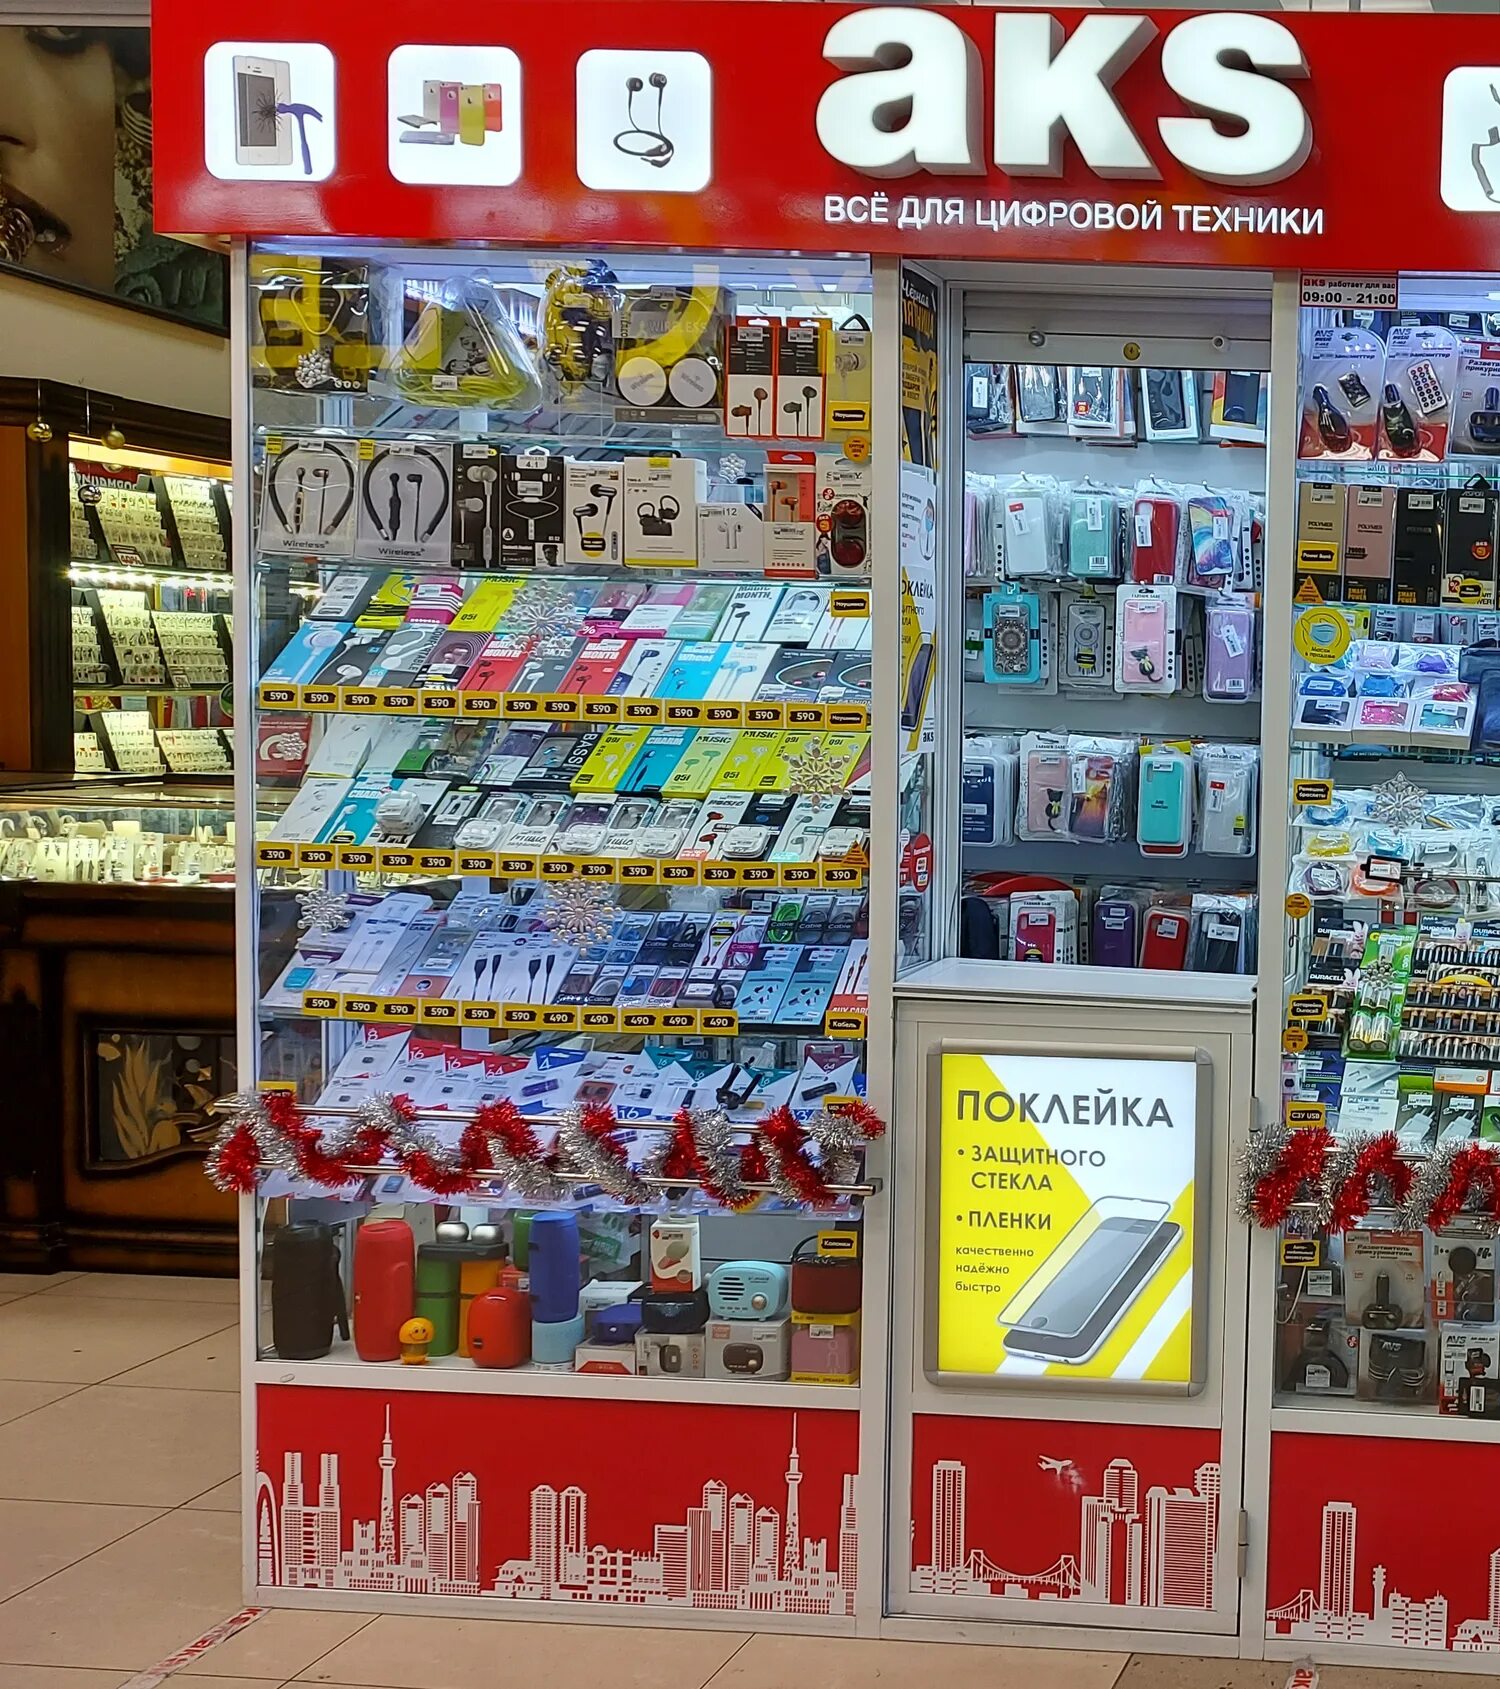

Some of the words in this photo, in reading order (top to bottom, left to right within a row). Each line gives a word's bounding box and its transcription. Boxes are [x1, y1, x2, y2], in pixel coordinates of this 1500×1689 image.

[815, 7, 1313, 186] aks
[824, 191, 888, 223] ВСЁ
[898, 197, 964, 230] ДЛЯ
[975, 199, 1162, 232] ЦИФРОВОЙ
[1177, 204, 1324, 234] ТЕХНИКИ
[1328, 281, 1364, 289] работает
[1365, 282, 1380, 290] для
[1303, 292, 1342, 303] 09:00
[1356, 293, 1396, 305] 21:00
[526, 461, 539, 469] 4.1
[283, 539, 327, 549] Wireless
[378, 547, 423, 557] Wireless
[271, 692, 287, 700] 590
[311, 694, 328, 702] 590
[391, 697, 408, 705] 590
[432, 699, 448, 707] 590
[552, 703, 569, 711] 590
[593, 705, 610, 713] 590
[715, 710, 732, 718] 590
[756, 711, 773, 719] 590
[428, 858, 445, 866] 390
[469, 860, 485, 868] 390
[509, 862, 526, 870] 390
[550, 864, 567, 872] 390
[629, 867, 646, 875] 390
[712, 870, 728, 878] 390
[833, 871, 850, 879] 390
[313, 999, 329, 1007] 590
[353, 1003, 370, 1011] 590
[513, 1012, 529, 1020] 590
[710, 1018, 728, 1026] 490
[957, 1088, 1174, 1128] ПОКЛЕЙКА
[971, 1145, 1106, 1167] ЗАЩИТНОГО
[971, 1172, 1053, 1191] СТЕКЛА
[969, 1211, 1051, 1230] ПЛЕНКИ
[955, 1247, 1034, 1257] качественно
[955, 1263, 1010, 1275] надёжно
[955, 1281, 1001, 1293] быстро
[1446, 1336, 1467, 1345] AVS
